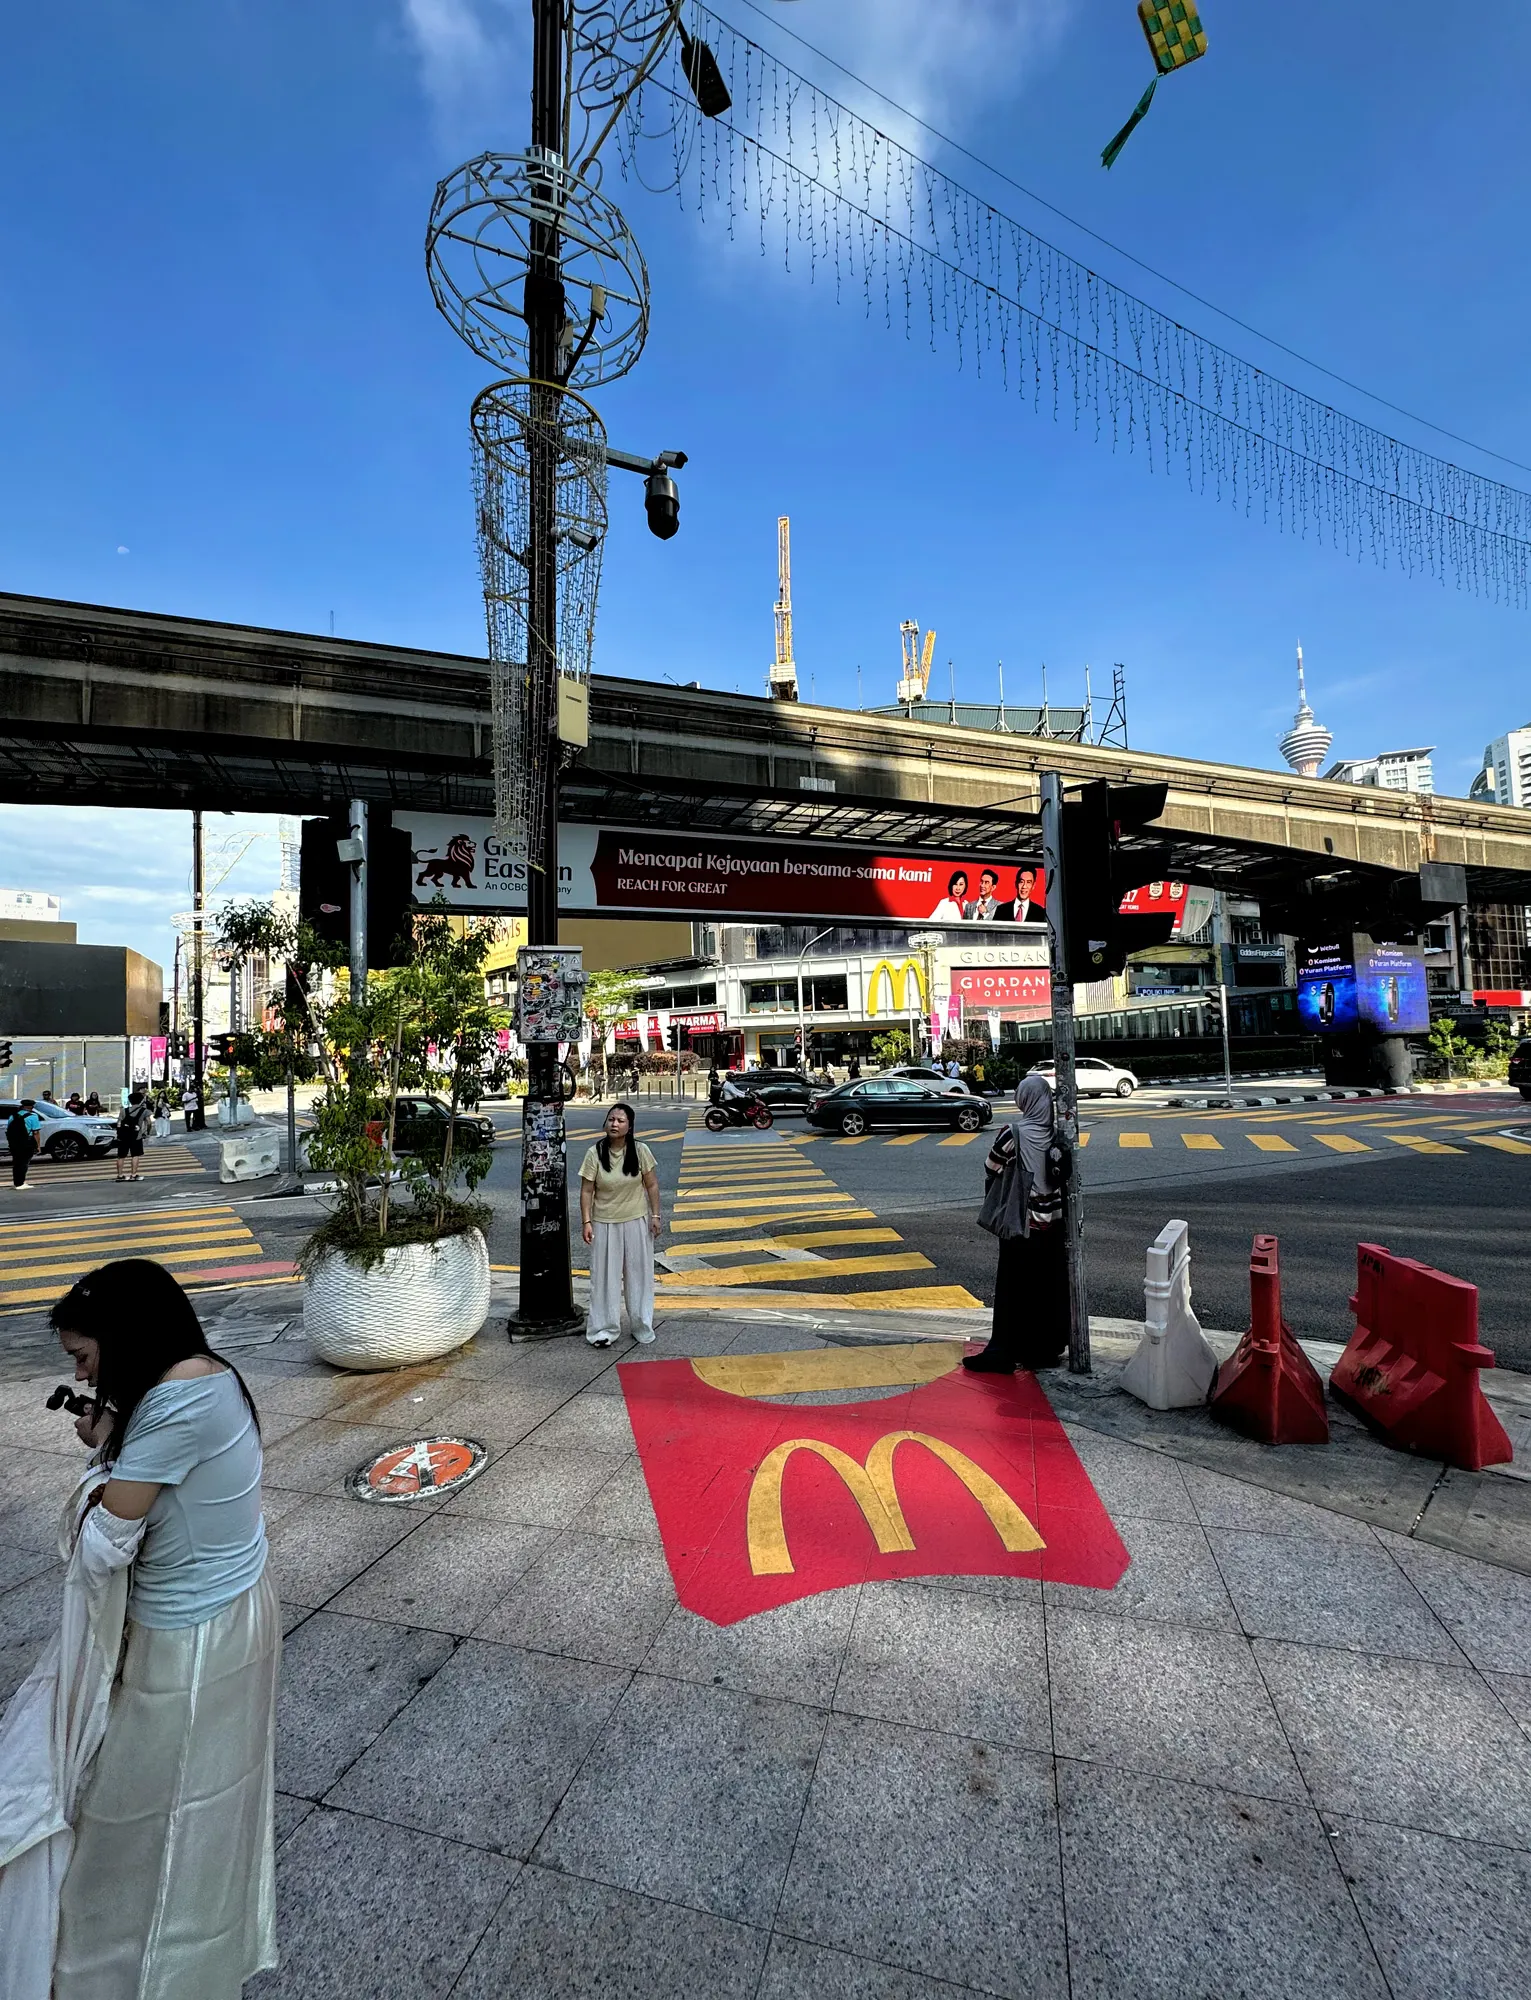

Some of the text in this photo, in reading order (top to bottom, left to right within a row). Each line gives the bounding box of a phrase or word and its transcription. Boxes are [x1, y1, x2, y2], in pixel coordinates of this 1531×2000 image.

[484, 836, 527, 857] Gre
[484, 858, 573, 881] Easn
[618, 848, 933, 883] Mencapai Kejayaan bersama-sama kami
[485, 882, 528, 892] An OCBC
[617, 878, 728, 895] REACH FOR GREAT
[960, 950, 1048, 964] GIORDAN
[1374, 959, 1390, 967] Yuran
[1390, 959, 1413, 967] Platform
[1304, 967, 1323, 975] Yuran
[1323, 963, 1352, 973] Platform
[984, 989, 1037, 998] OUTLET
